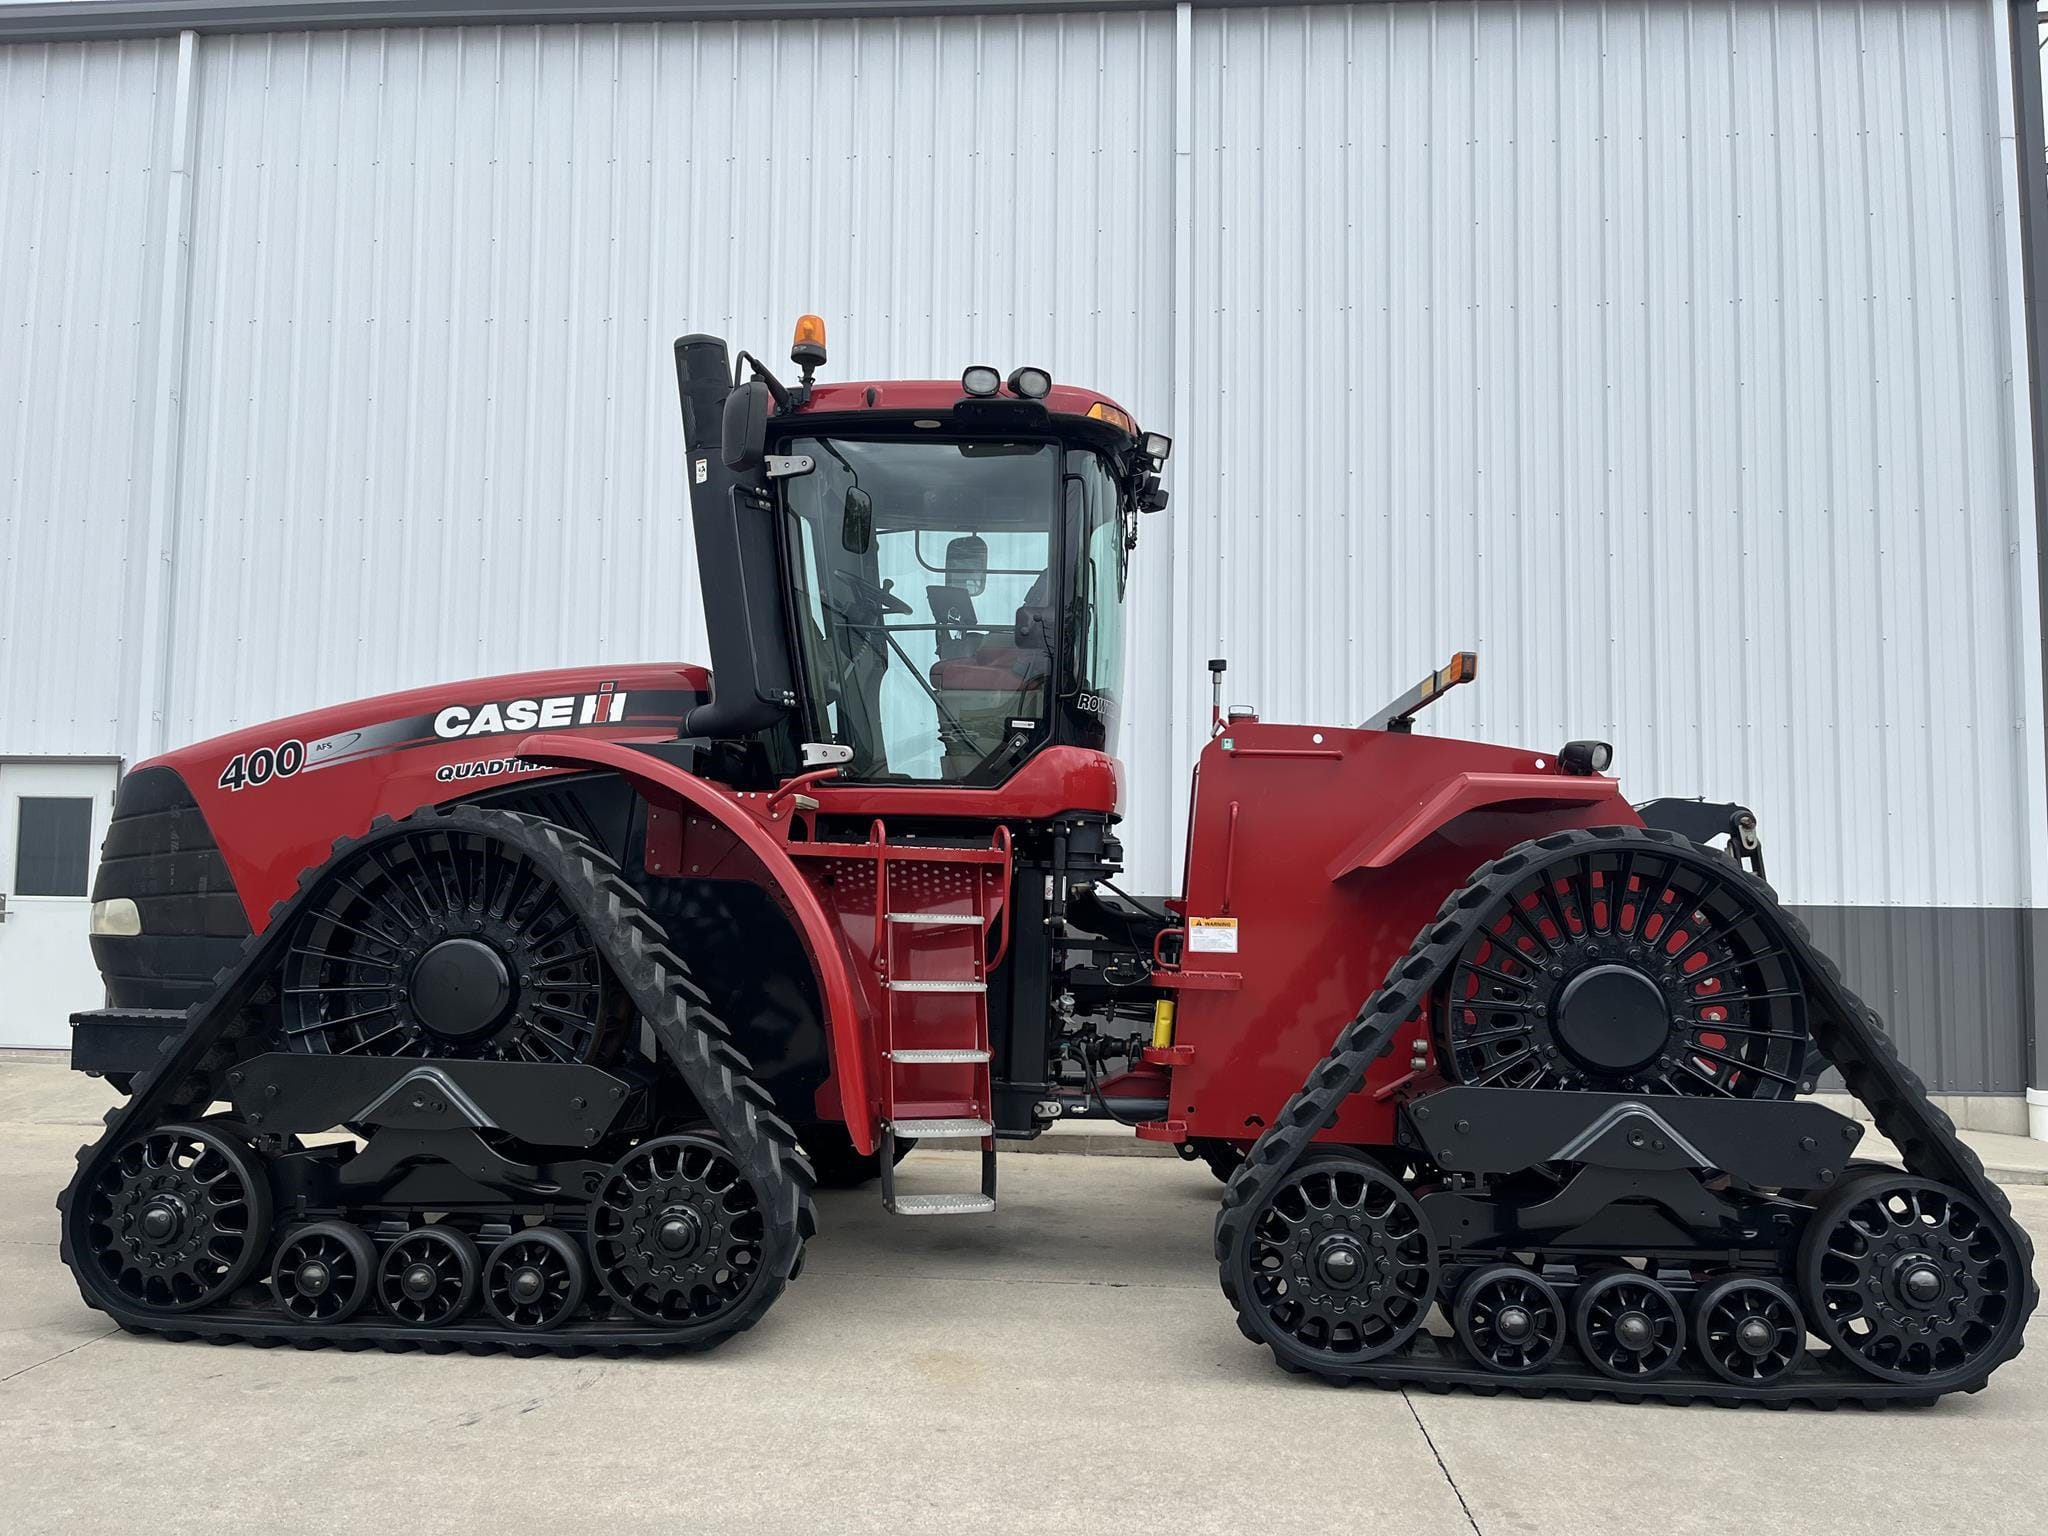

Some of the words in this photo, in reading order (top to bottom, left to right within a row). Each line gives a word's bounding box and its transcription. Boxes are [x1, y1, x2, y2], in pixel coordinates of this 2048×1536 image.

[433, 696, 576, 738] CASE
[316, 742, 333, 752] AFS
[217, 739, 305, 792] 400
[435, 757, 552, 783] QUADTR
